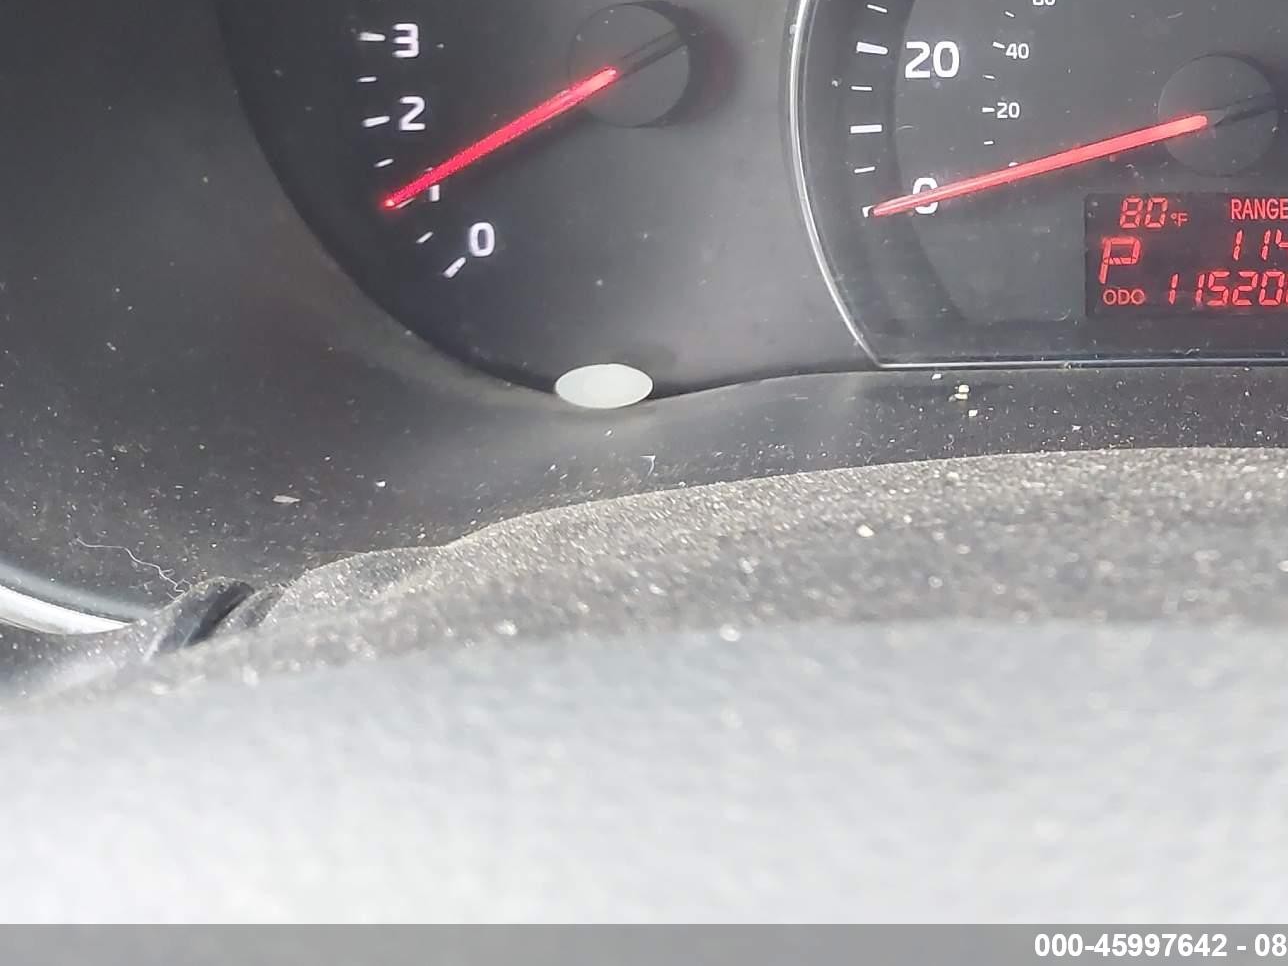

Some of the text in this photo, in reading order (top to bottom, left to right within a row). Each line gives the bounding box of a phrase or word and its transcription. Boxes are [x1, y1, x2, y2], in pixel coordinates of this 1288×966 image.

[394, 23, 419, 58] 3
[1005, 43, 1029, 60] 40
[905, 40, 960, 79] 20
[400, 96, 425, 131] 2
[996, 102, 1020, 119] 20
[912, 177, 939, 215] 0
[1119, 197, 1168, 229] 80
[1231, 198, 1288, 220] RANGE
[469, 222, 495, 257] 0
[1099, 235, 1142, 284] P
[1103, 288, 1145, 305] ODO
